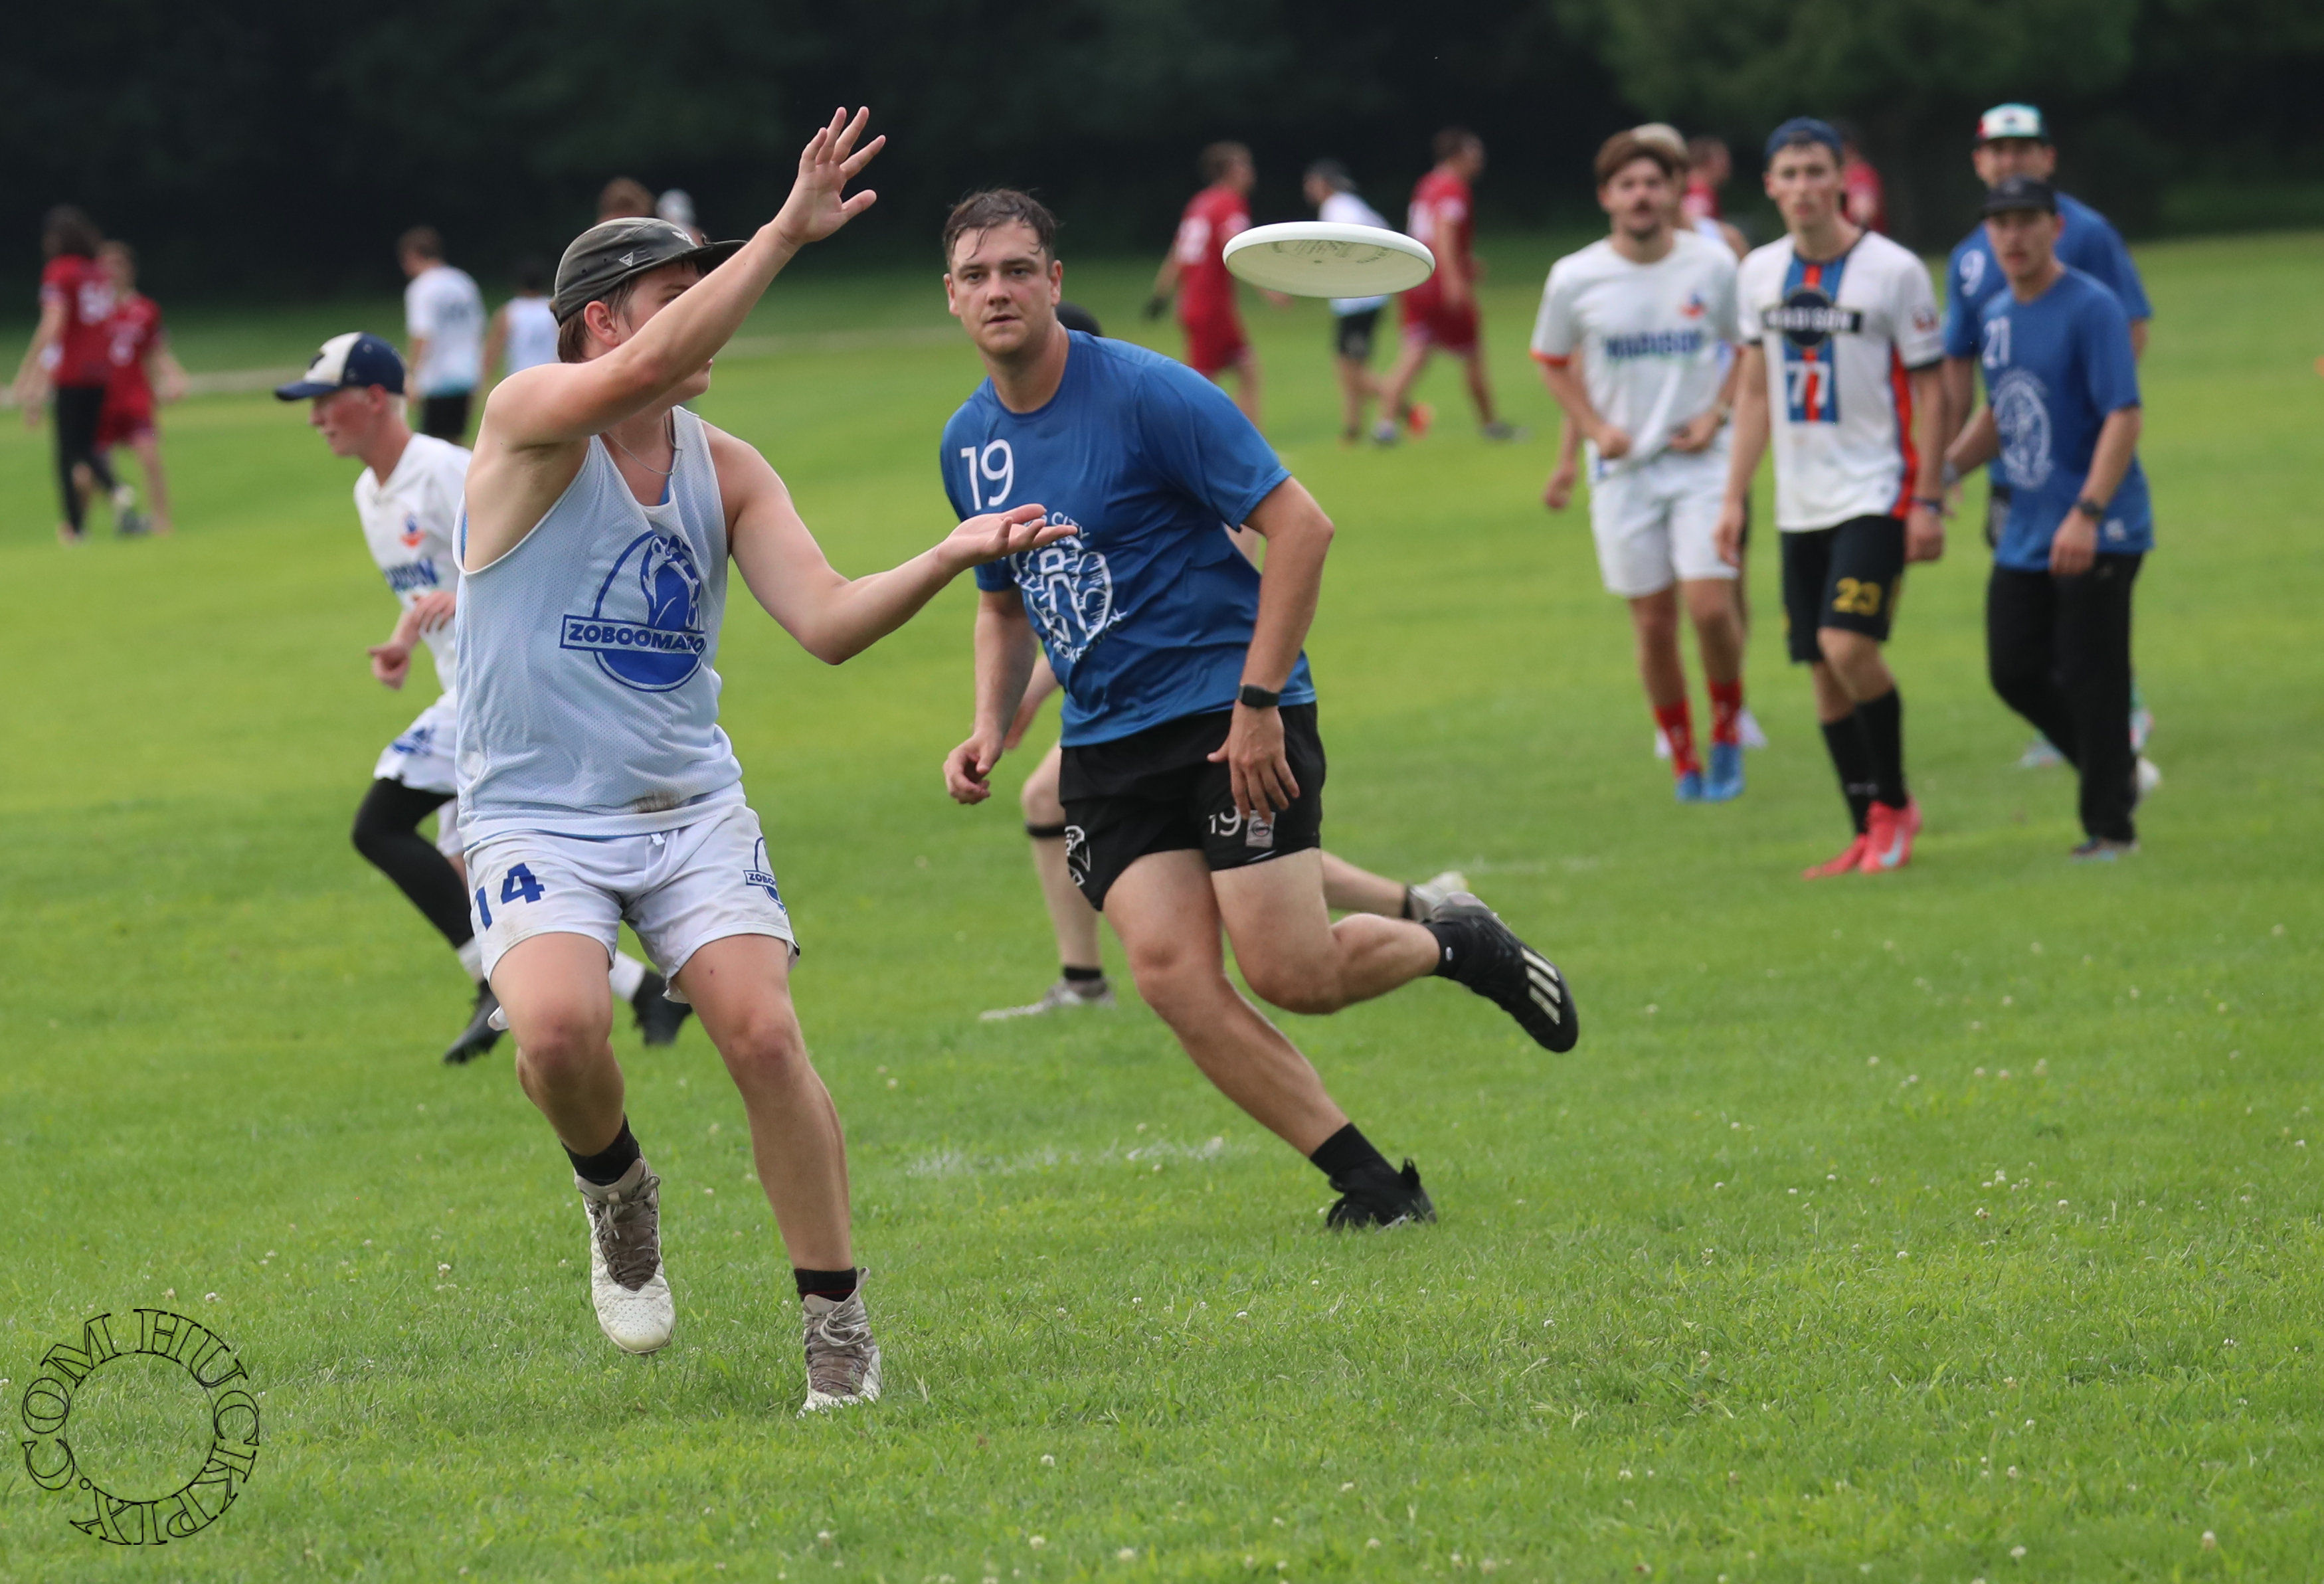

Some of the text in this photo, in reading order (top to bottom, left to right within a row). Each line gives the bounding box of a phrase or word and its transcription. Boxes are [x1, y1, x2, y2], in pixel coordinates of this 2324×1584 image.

[960, 438, 1014, 511] 19
[1832, 576, 1882, 617] 23
[1209, 805, 1241, 836] 19
[476, 862, 545, 932] 14
